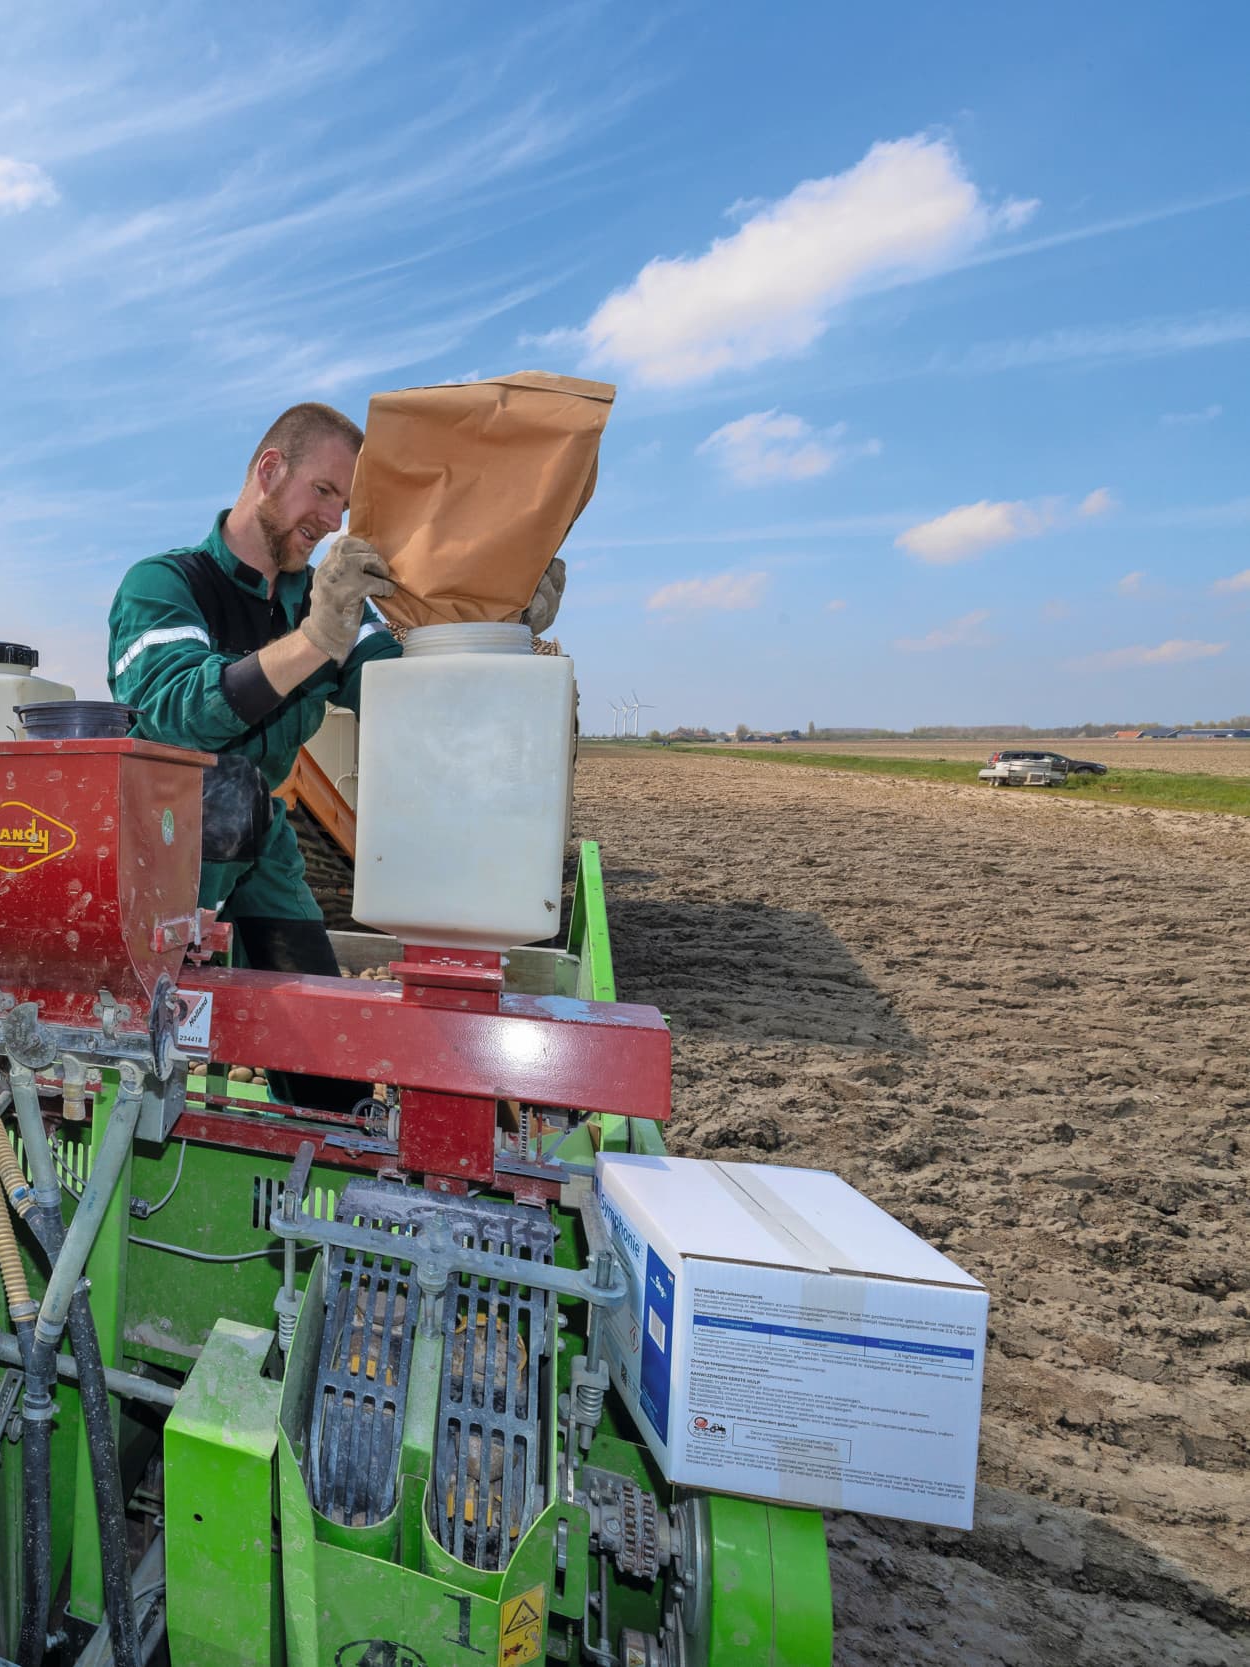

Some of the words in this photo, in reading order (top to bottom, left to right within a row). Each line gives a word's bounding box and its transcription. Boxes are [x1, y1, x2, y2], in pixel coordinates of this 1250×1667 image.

[189, 996, 208, 1027] Holland
[601, 1193, 641, 1258] Symphonie
[443, 1593, 487, 1655] 1
